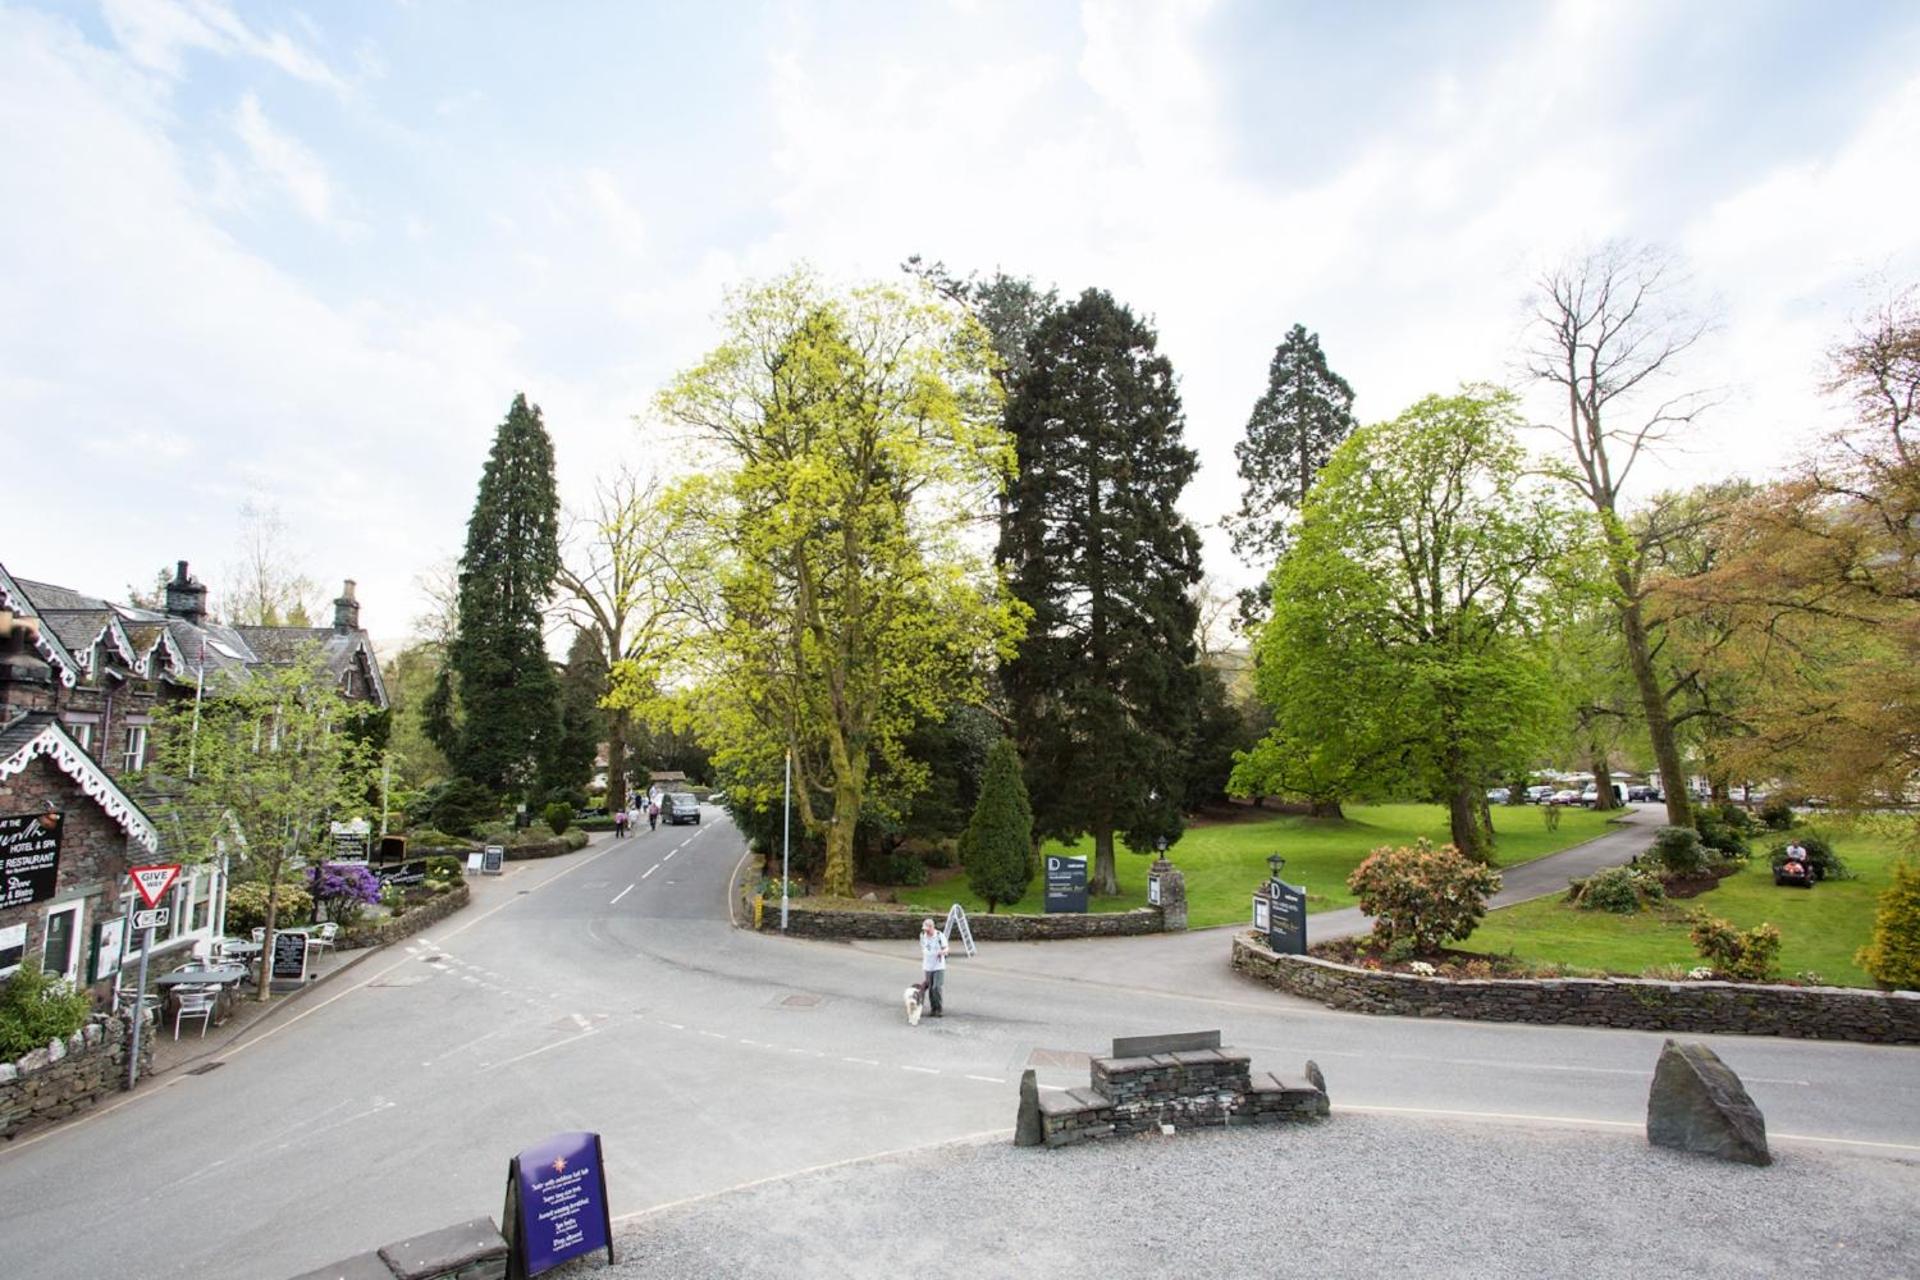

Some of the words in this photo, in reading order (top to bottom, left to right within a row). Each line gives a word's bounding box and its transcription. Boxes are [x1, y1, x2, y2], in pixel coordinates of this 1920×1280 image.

[9, 842, 34, 854] HOTEL
[42, 839, 57, 849] SPA
[5, 852, 55, 868] RESTAURANT
[1048, 857, 1061, 871] D
[141, 871, 168, 881] GIVE
[1271, 883, 1280, 900] D
